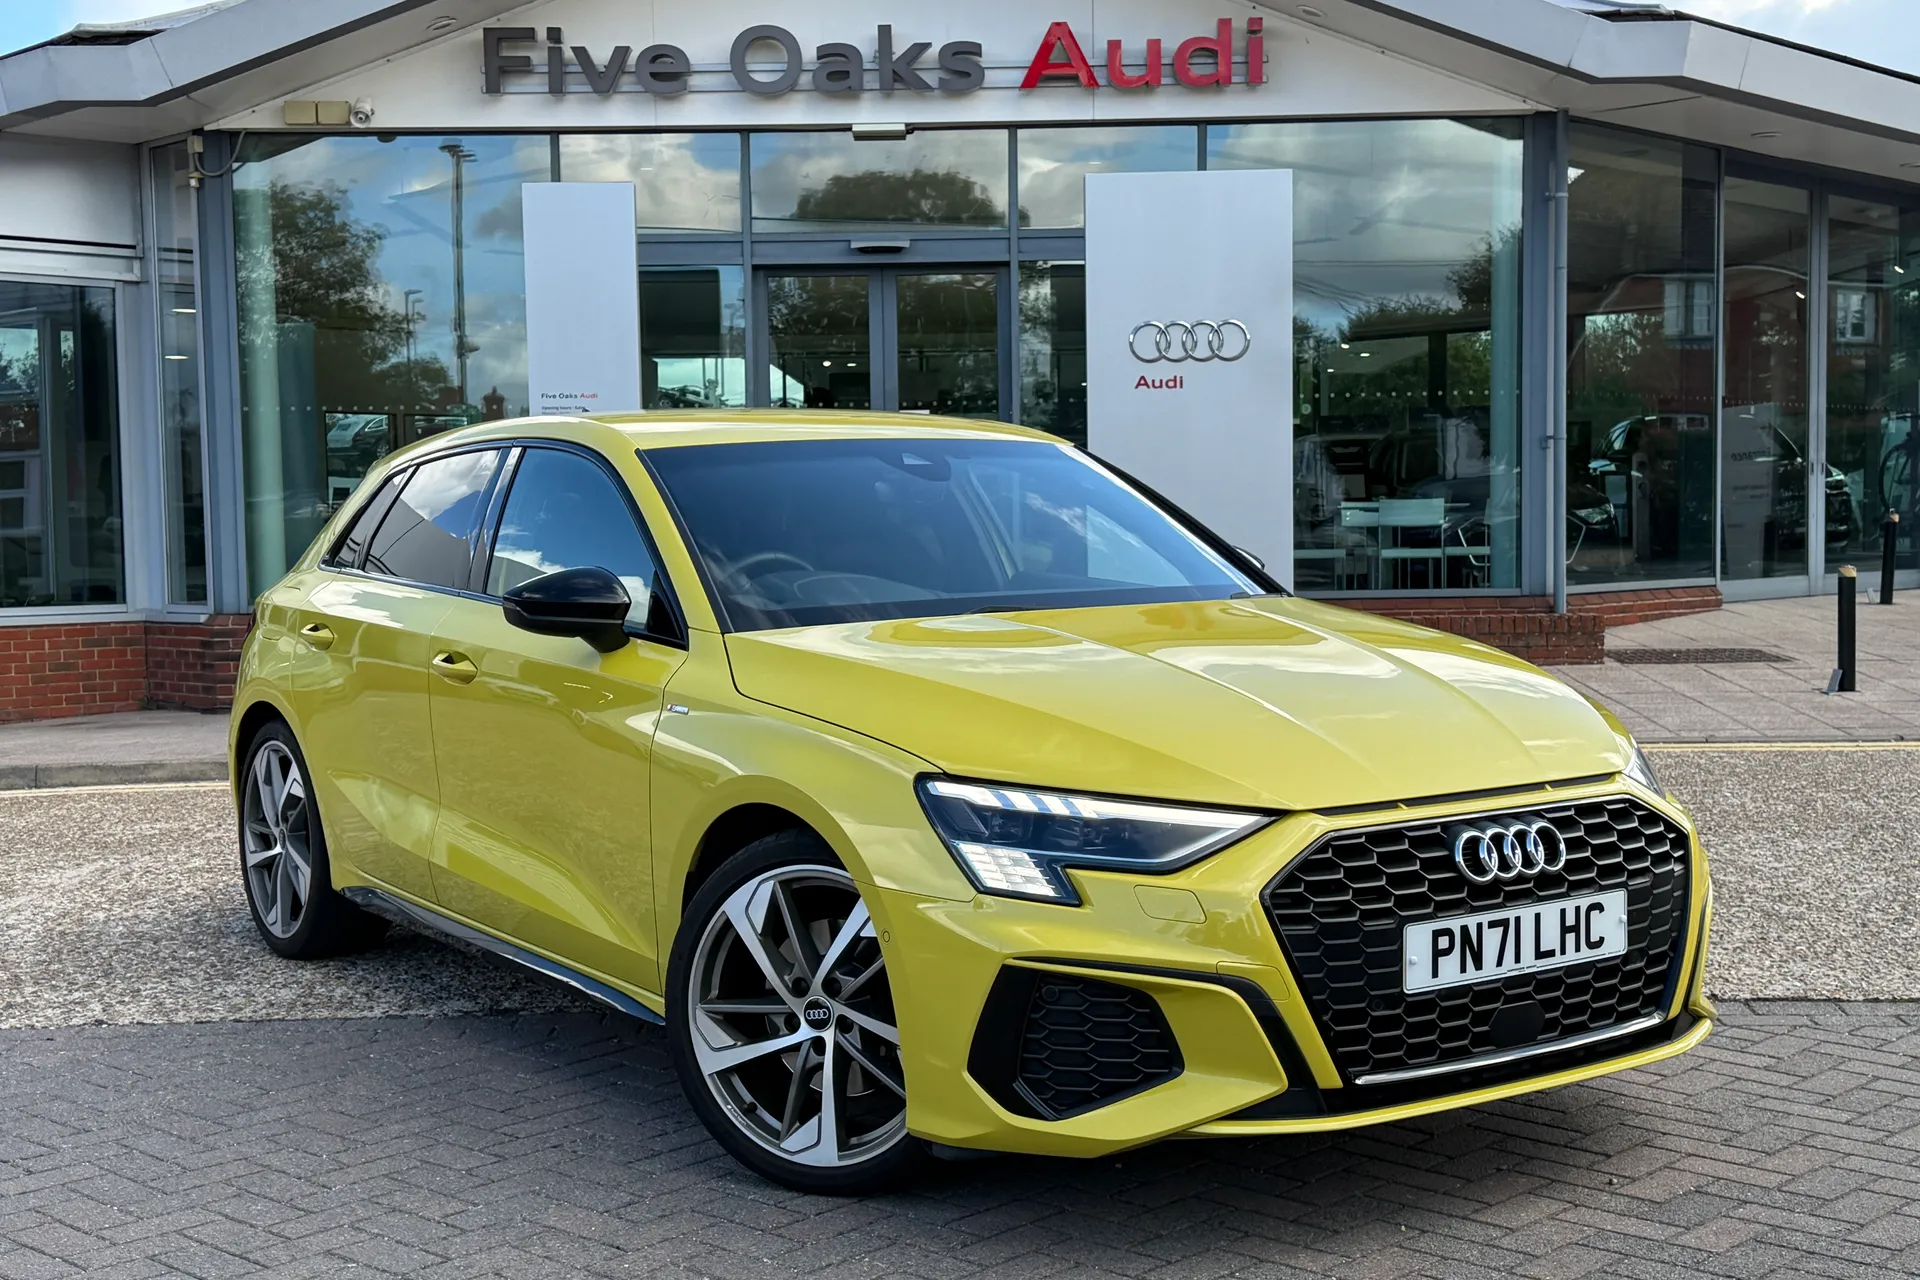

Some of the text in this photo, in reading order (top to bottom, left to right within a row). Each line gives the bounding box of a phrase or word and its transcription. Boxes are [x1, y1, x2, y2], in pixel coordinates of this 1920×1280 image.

[482, 17, 1265, 96] Five Oaks Audi
[1134, 375, 1184, 389] Audi
[1431, 901, 1606, 979] PN71 LHC
